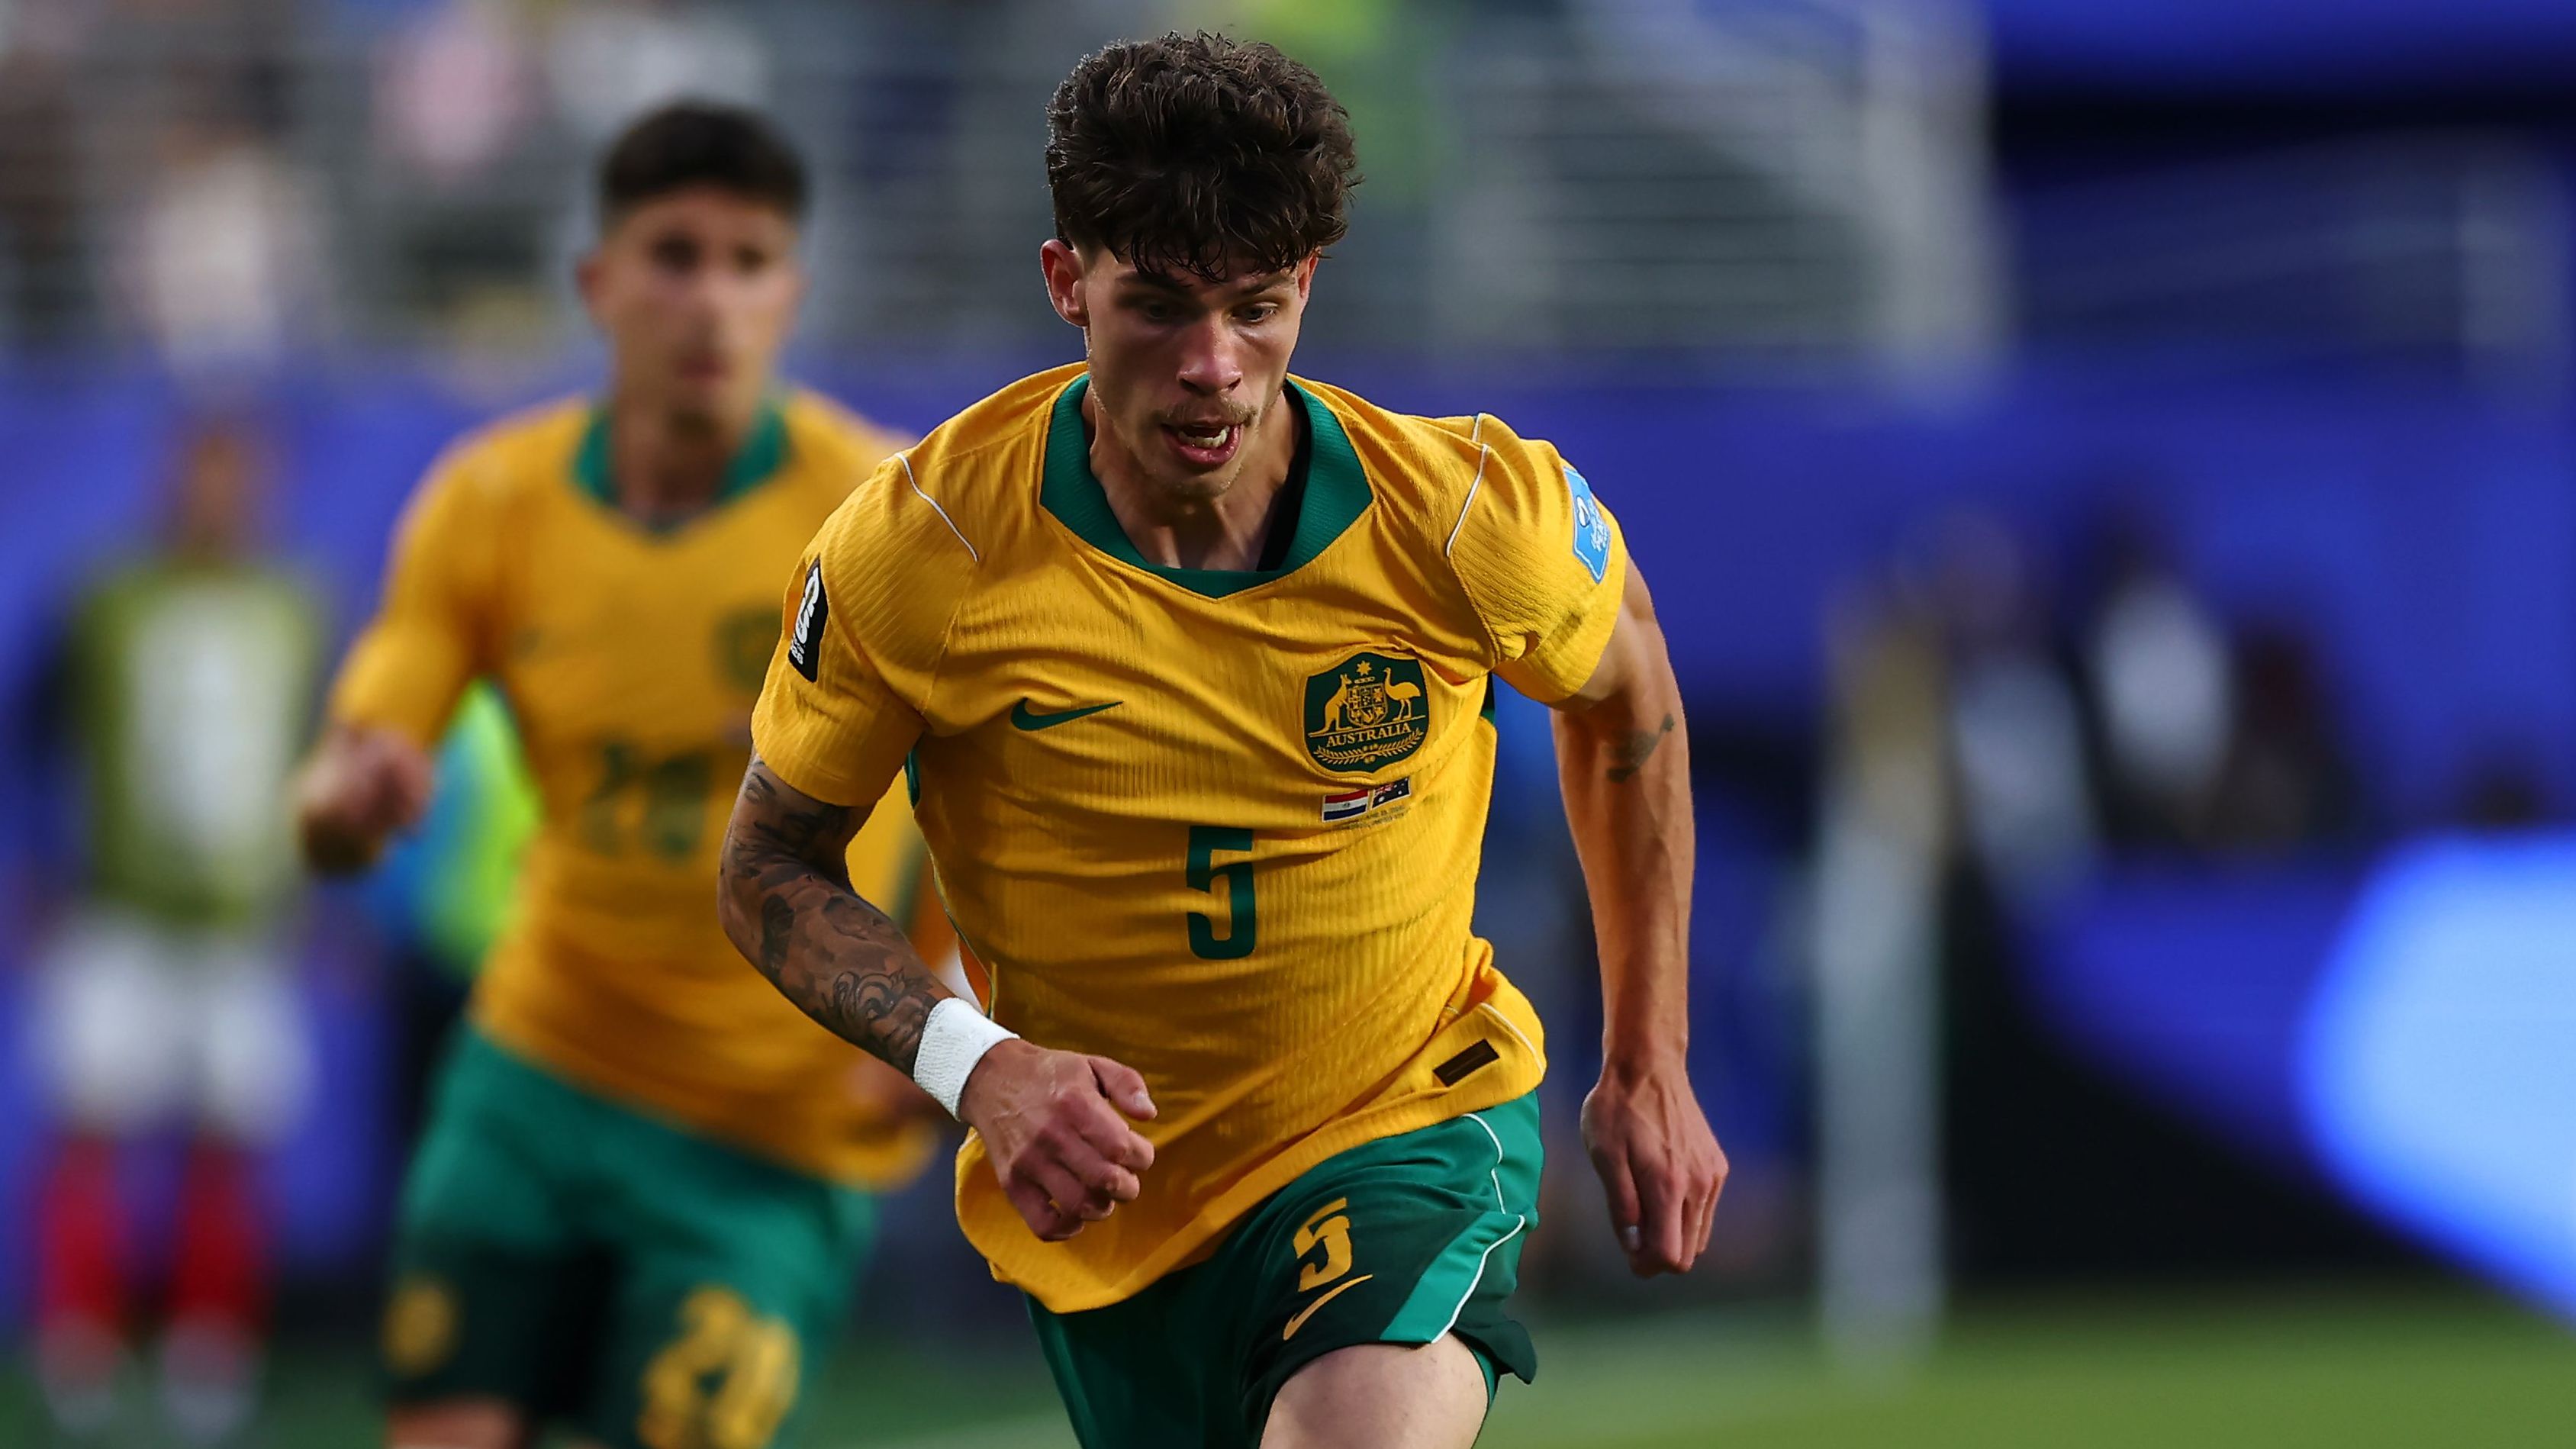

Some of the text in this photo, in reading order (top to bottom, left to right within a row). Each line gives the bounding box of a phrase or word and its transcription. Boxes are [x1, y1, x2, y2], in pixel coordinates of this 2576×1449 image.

[1326, 723, 1412, 748] AUSTRALIA
[1186, 825, 1256, 961] 5
[1293, 1196, 1353, 1293] 5
